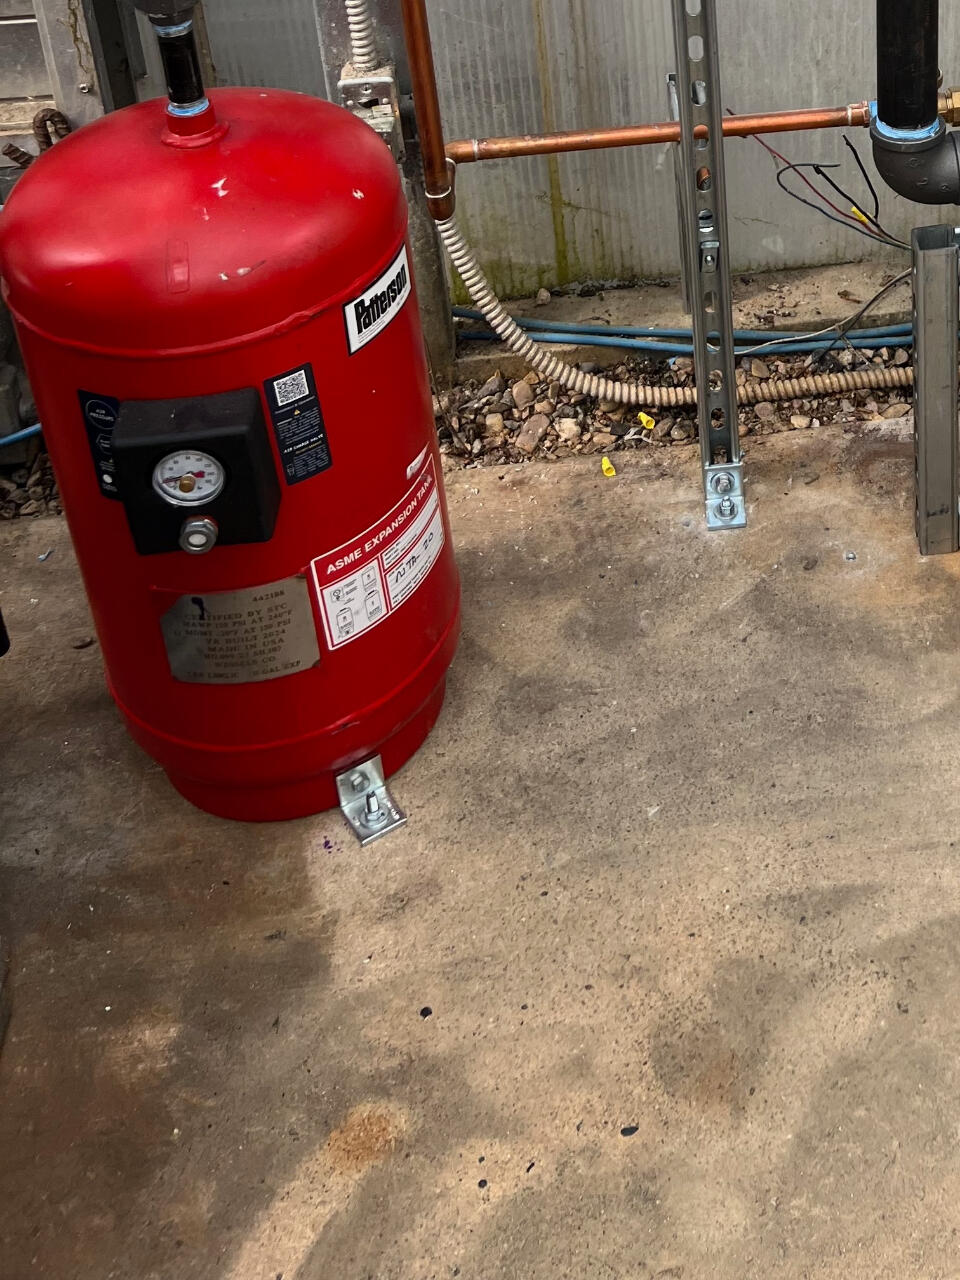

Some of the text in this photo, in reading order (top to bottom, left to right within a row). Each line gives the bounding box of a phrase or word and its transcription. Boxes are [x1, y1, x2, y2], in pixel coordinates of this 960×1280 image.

[354, 263, 407, 335] Patterson
[326, 549, 363, 575] ASME
[364, 498, 418, 553] EXPANSION
[416, 475, 434, 501] TANK
